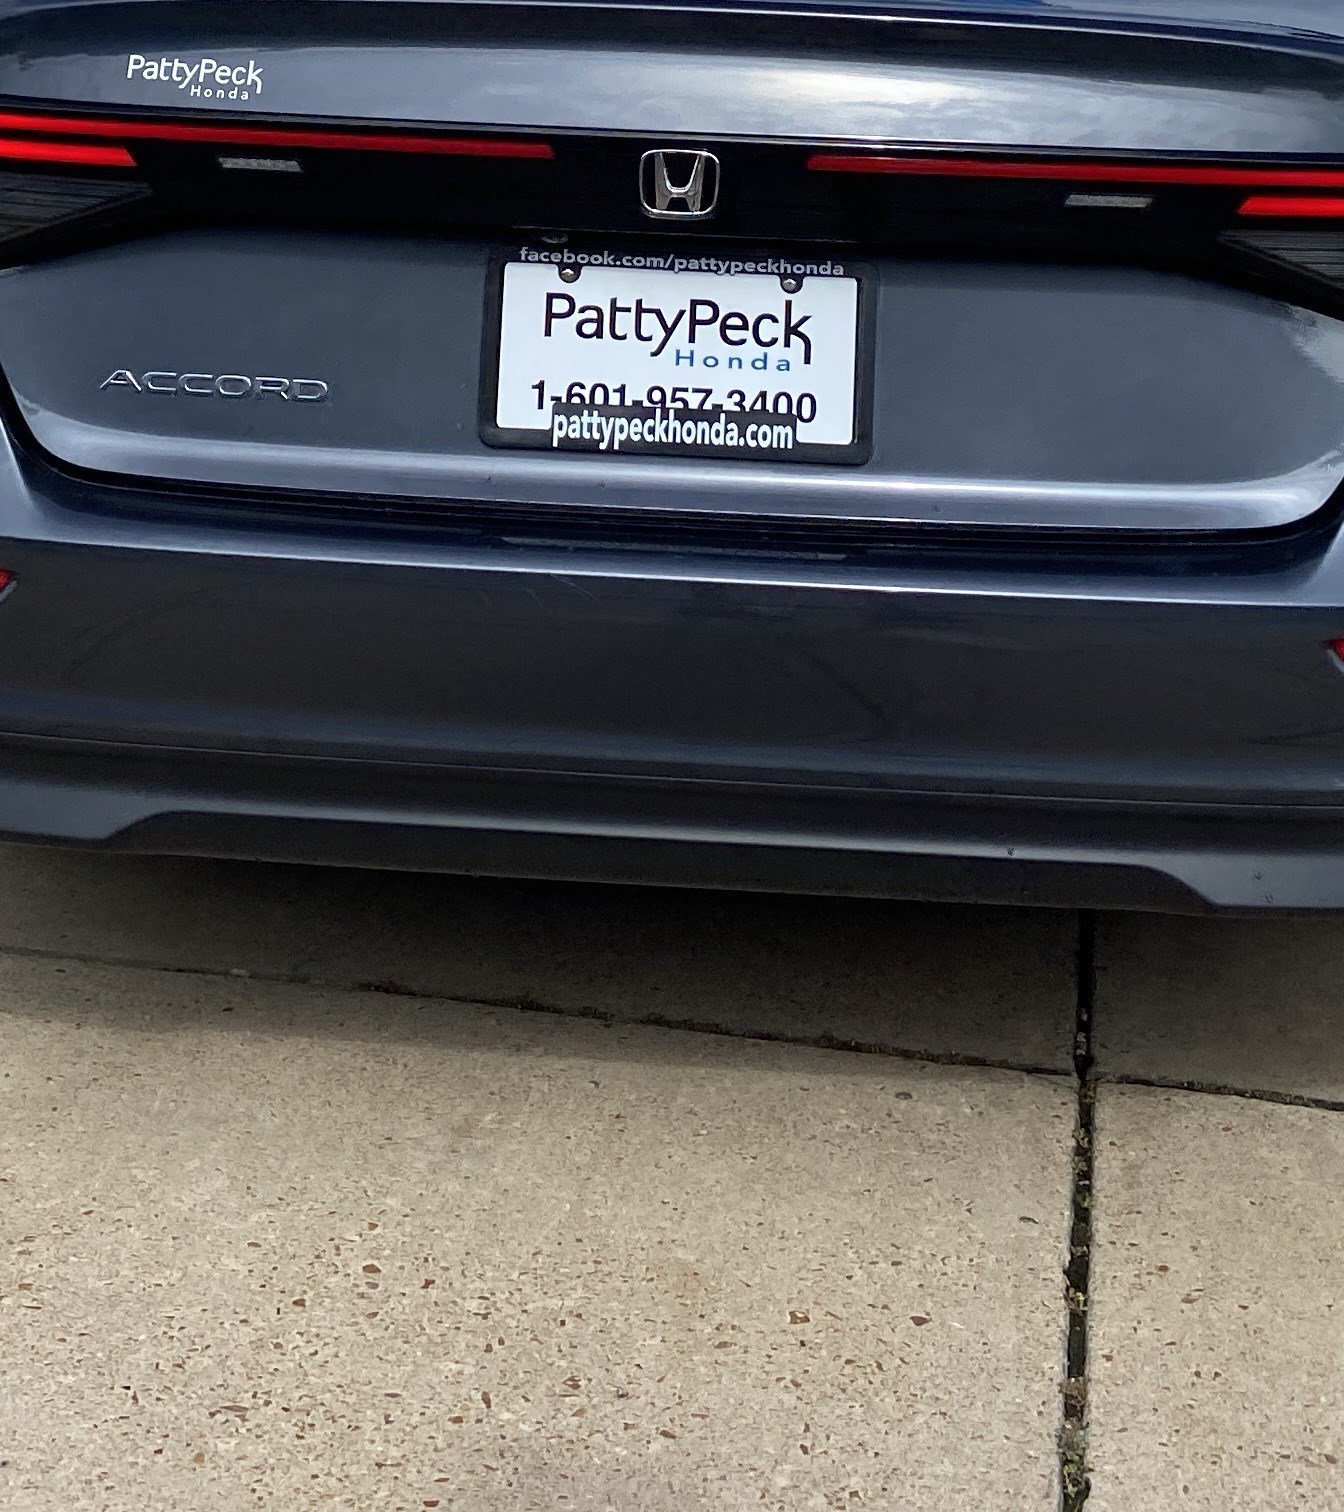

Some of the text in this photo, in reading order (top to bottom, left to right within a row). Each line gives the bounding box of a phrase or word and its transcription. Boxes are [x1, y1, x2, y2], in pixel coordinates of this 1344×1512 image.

[126, 54, 263, 94] PattyPeck
[190, 85, 249, 100] Honda
[519, 246, 844, 275] facebook.com/pattypeckhonda
[543, 291, 813, 365] PattyPeck
[674, 349, 792, 372] Honda
[100, 369, 330, 400] ACCORD
[531, 379, 817, 423] 1-601-957-3400
[552, 409, 794, 450] pattypeckhonda.com
